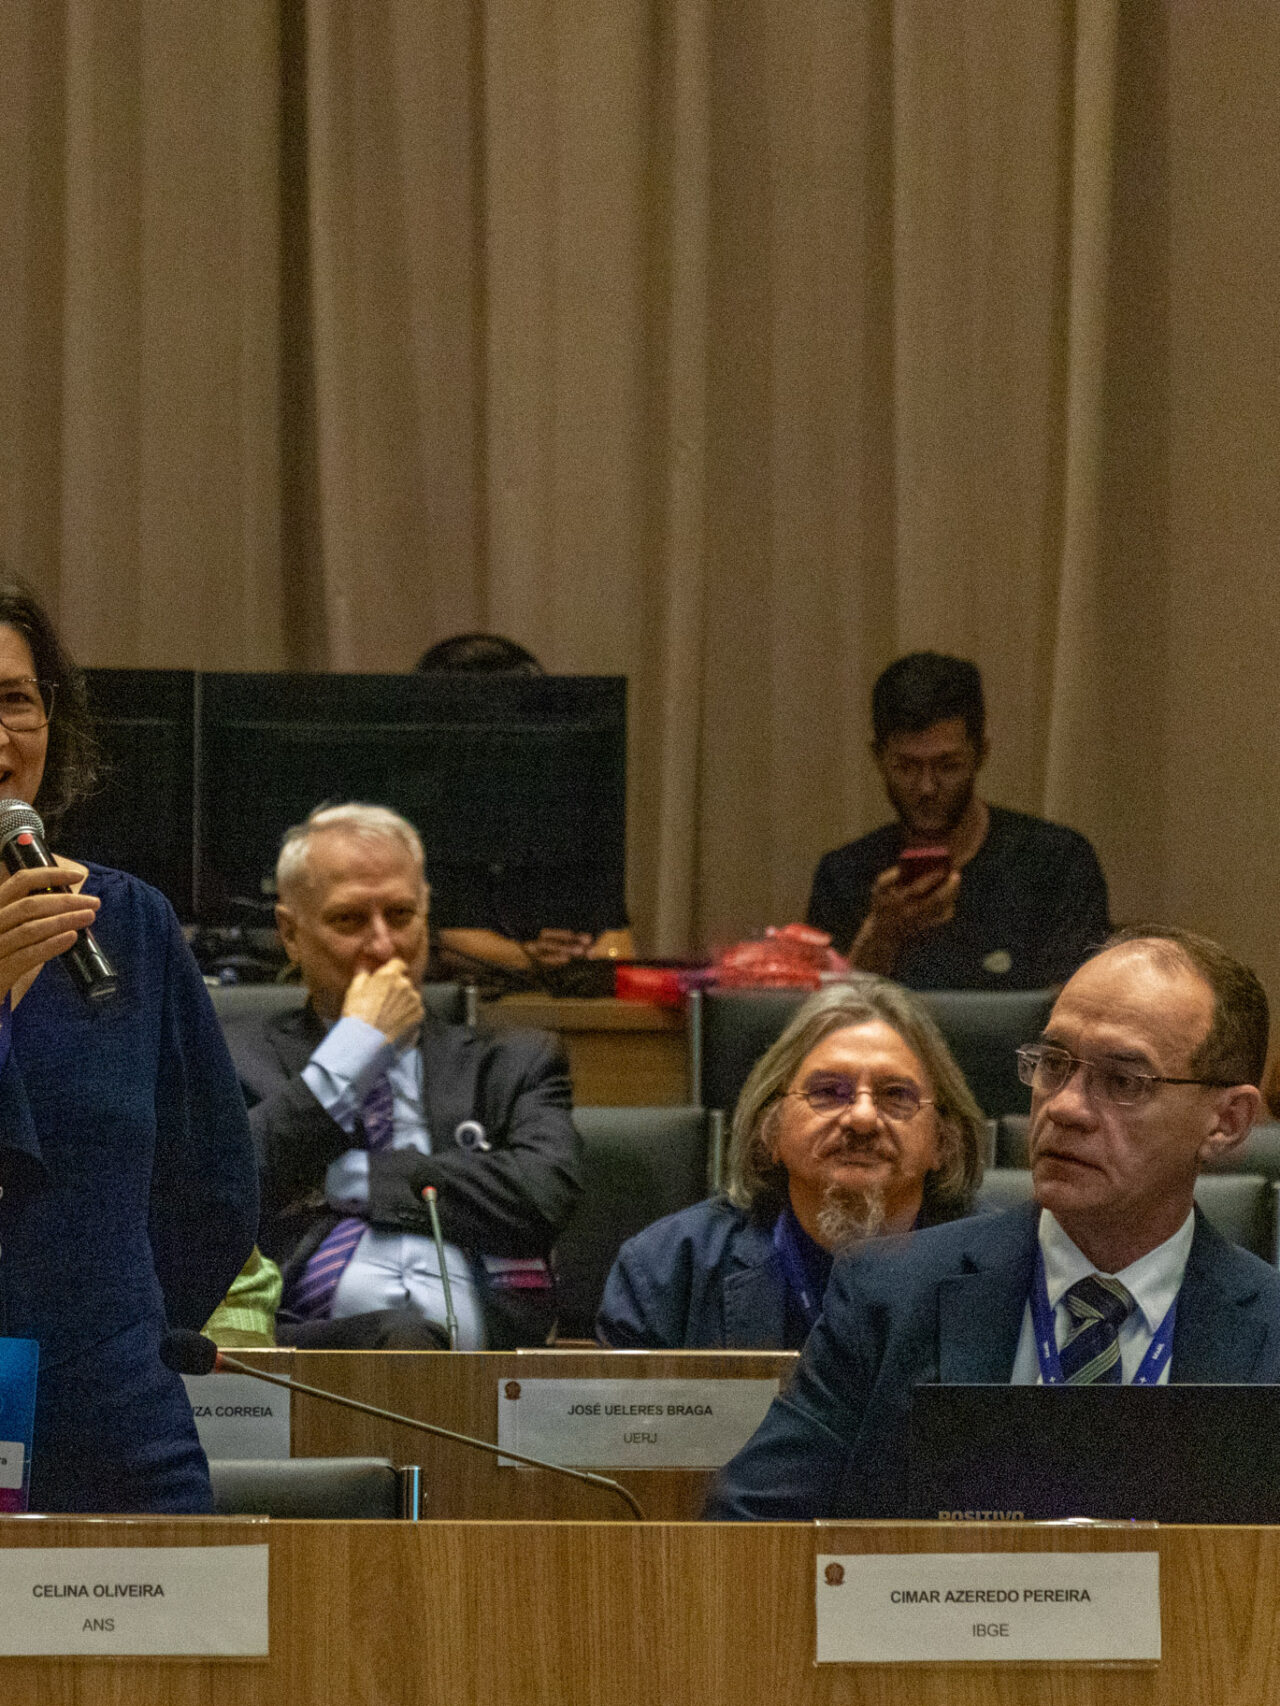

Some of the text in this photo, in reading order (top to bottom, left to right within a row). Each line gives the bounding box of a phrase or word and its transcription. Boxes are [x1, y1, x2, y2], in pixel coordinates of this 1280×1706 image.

[215, 1405, 273, 1417] CORREIA
[568, 1403, 713, 1416] JOSÉ UELERES BRAGA
[624, 1432, 657, 1444] UERJ
[32, 1584, 165, 1598] CELINA OLIVEIRA
[890, 1589, 1091, 1604] CIMAR AZEREDO PEREIRA
[82, 1618, 115, 1632] ANS
[972, 1623, 1010, 1637] IBGE
